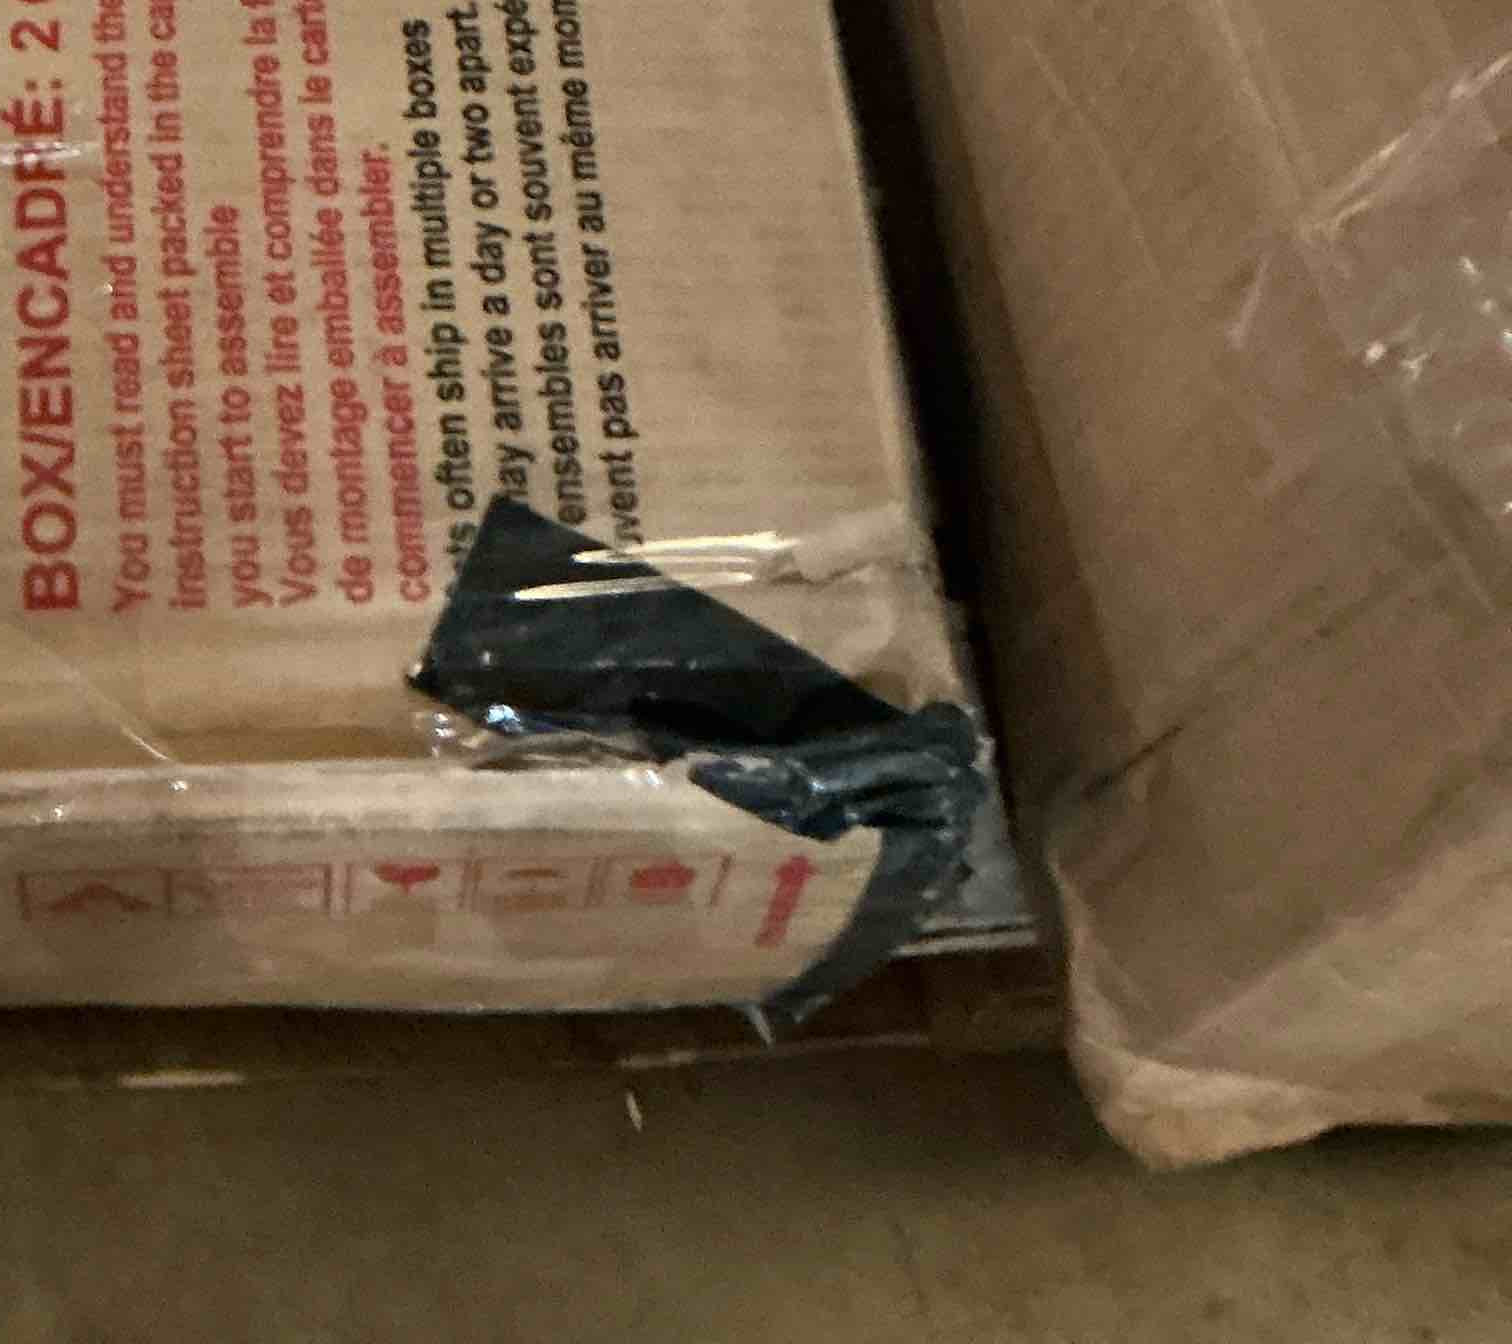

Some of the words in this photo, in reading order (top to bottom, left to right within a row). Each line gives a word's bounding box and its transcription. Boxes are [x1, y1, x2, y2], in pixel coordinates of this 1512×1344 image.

[10, 19, 59, 51] 2
[242, 18, 277, 44] la
[400, 19, 439, 119] boxes
[145, 52, 179, 102] the
[298, 77, 332, 104] le
[93, 53, 133, 243] understand
[147, 113, 183, 142] in
[245, 56, 295, 260] comprendre
[303, 115, 340, 197] dans
[460, 104, 493, 164] two
[506, 85, 553, 221] souvent
[148, 154, 195, 277] packed
[402, 129, 452, 267] multiple
[469, 176, 500, 209] or
[574, 192, 605, 232] au
[101, 256, 138, 321] and
[202, 205, 247, 377] assemble
[263, 273, 296, 305] et
[307, 208, 353, 369] emballée
[471, 223, 510, 284] day
[524, 231, 562, 310] sont
[419, 280, 456, 310] in
[483, 296, 509, 315] a
[579, 243, 622, 360] arriver
[0, 79, 81, 613] BOX/ENCADRÉ:
[104, 333, 142, 414] read
[155, 288, 195, 389] sheet
[264, 317, 301, 373] lire
[425, 322, 467, 401] ship
[482, 328, 524, 430] arrive
[218, 387, 251, 425] to
[269, 384, 310, 494] devez
[535, 322, 587, 527] ensembles
[594, 373, 639, 439] pas
[108, 425, 147, 521] must
[218, 435, 257, 523] start
[327, 378, 367, 544] montage
[380, 377, 433, 603] commencer
[433, 414, 475, 510] often
[161, 400, 207, 610] instruction
[106, 533, 152, 612] You
[230, 536, 273, 608] you
[277, 507, 317, 605] Vous
[339, 556, 375, 604] de
